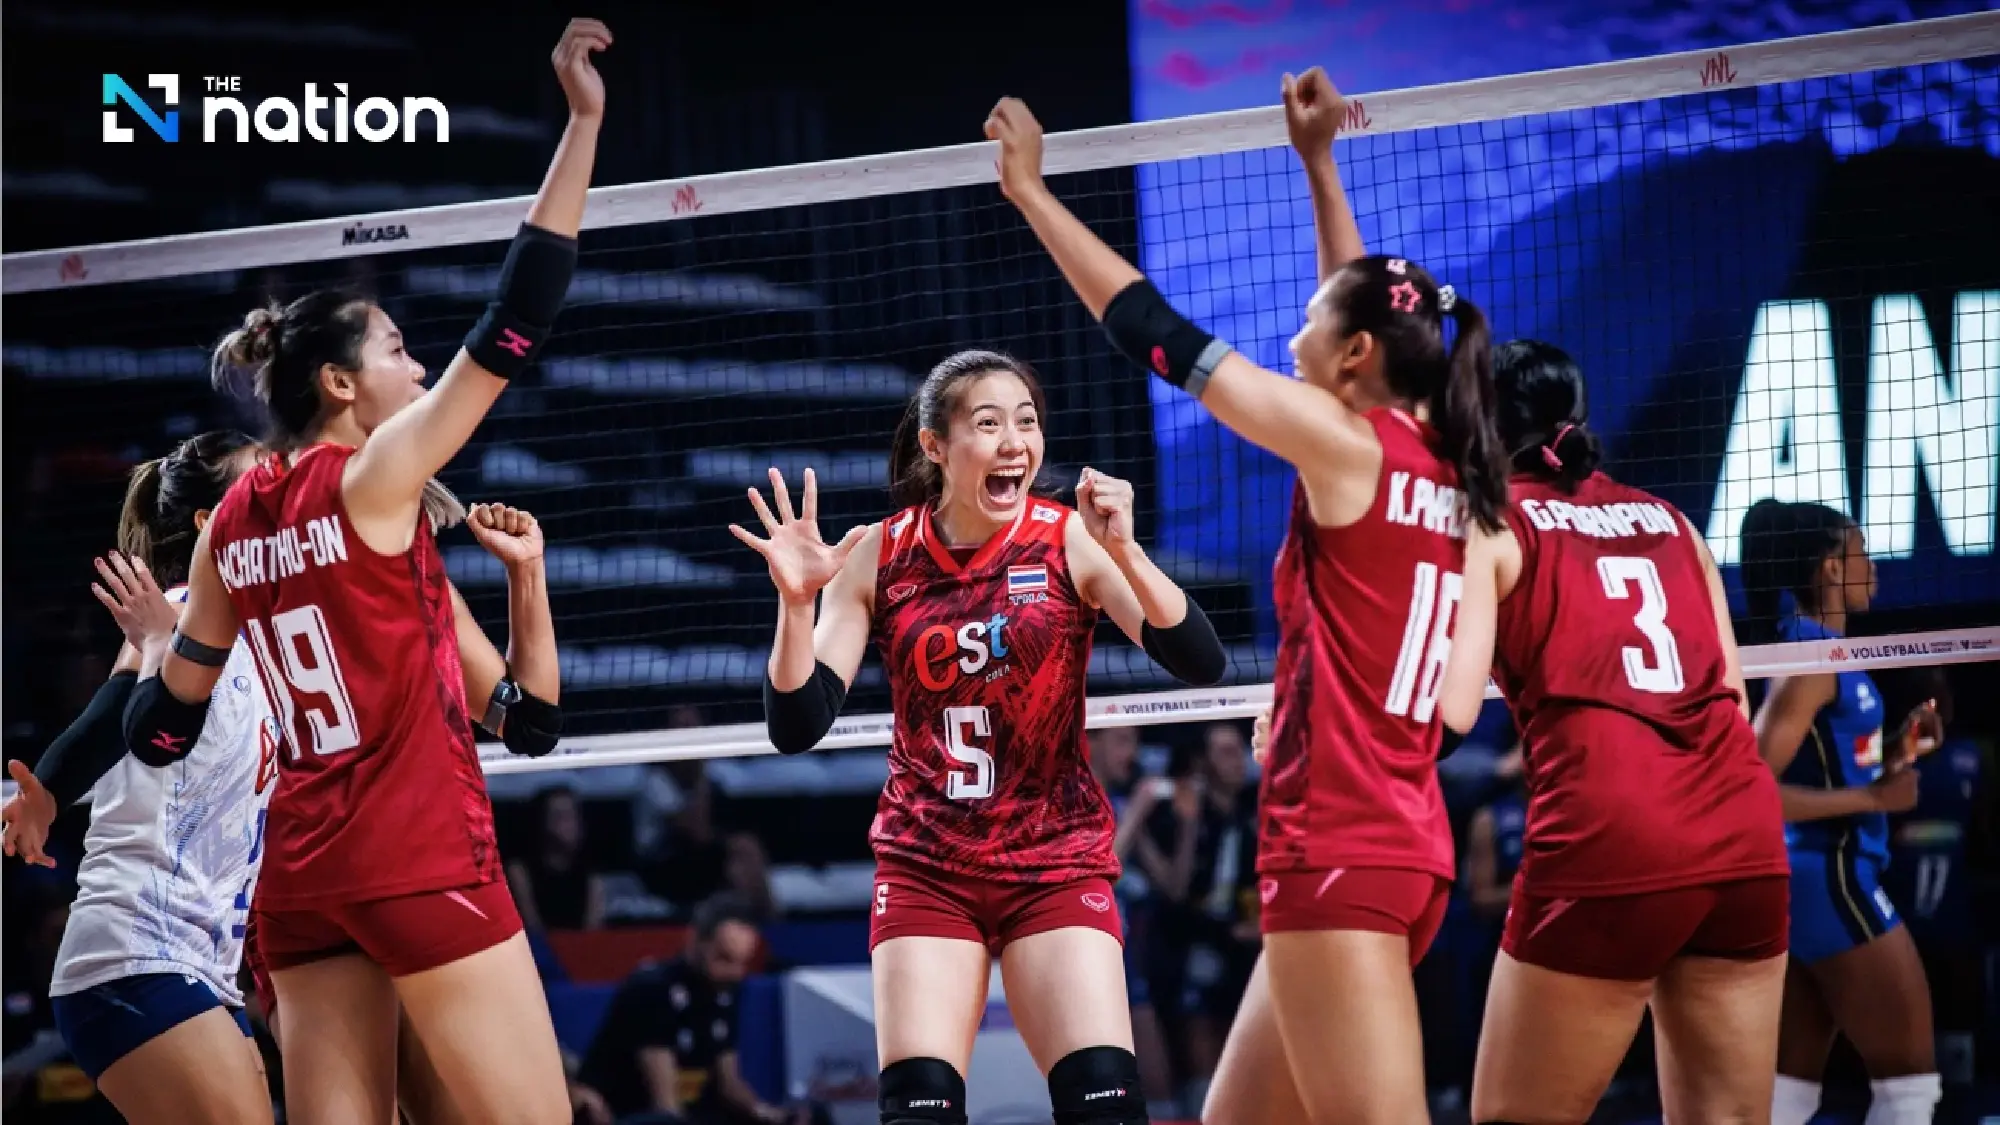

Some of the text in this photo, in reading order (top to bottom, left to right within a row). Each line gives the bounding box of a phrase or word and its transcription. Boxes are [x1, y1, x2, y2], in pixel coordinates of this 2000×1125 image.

[1704, 289, 2000, 566] AN
[914, 613, 1008, 692] est
[1597, 556, 1685, 693] 3
[1851, 642, 1930, 660] VOLLEYBALL
[247, 605, 361, 760] 19
[944, 706, 995, 799] 5
